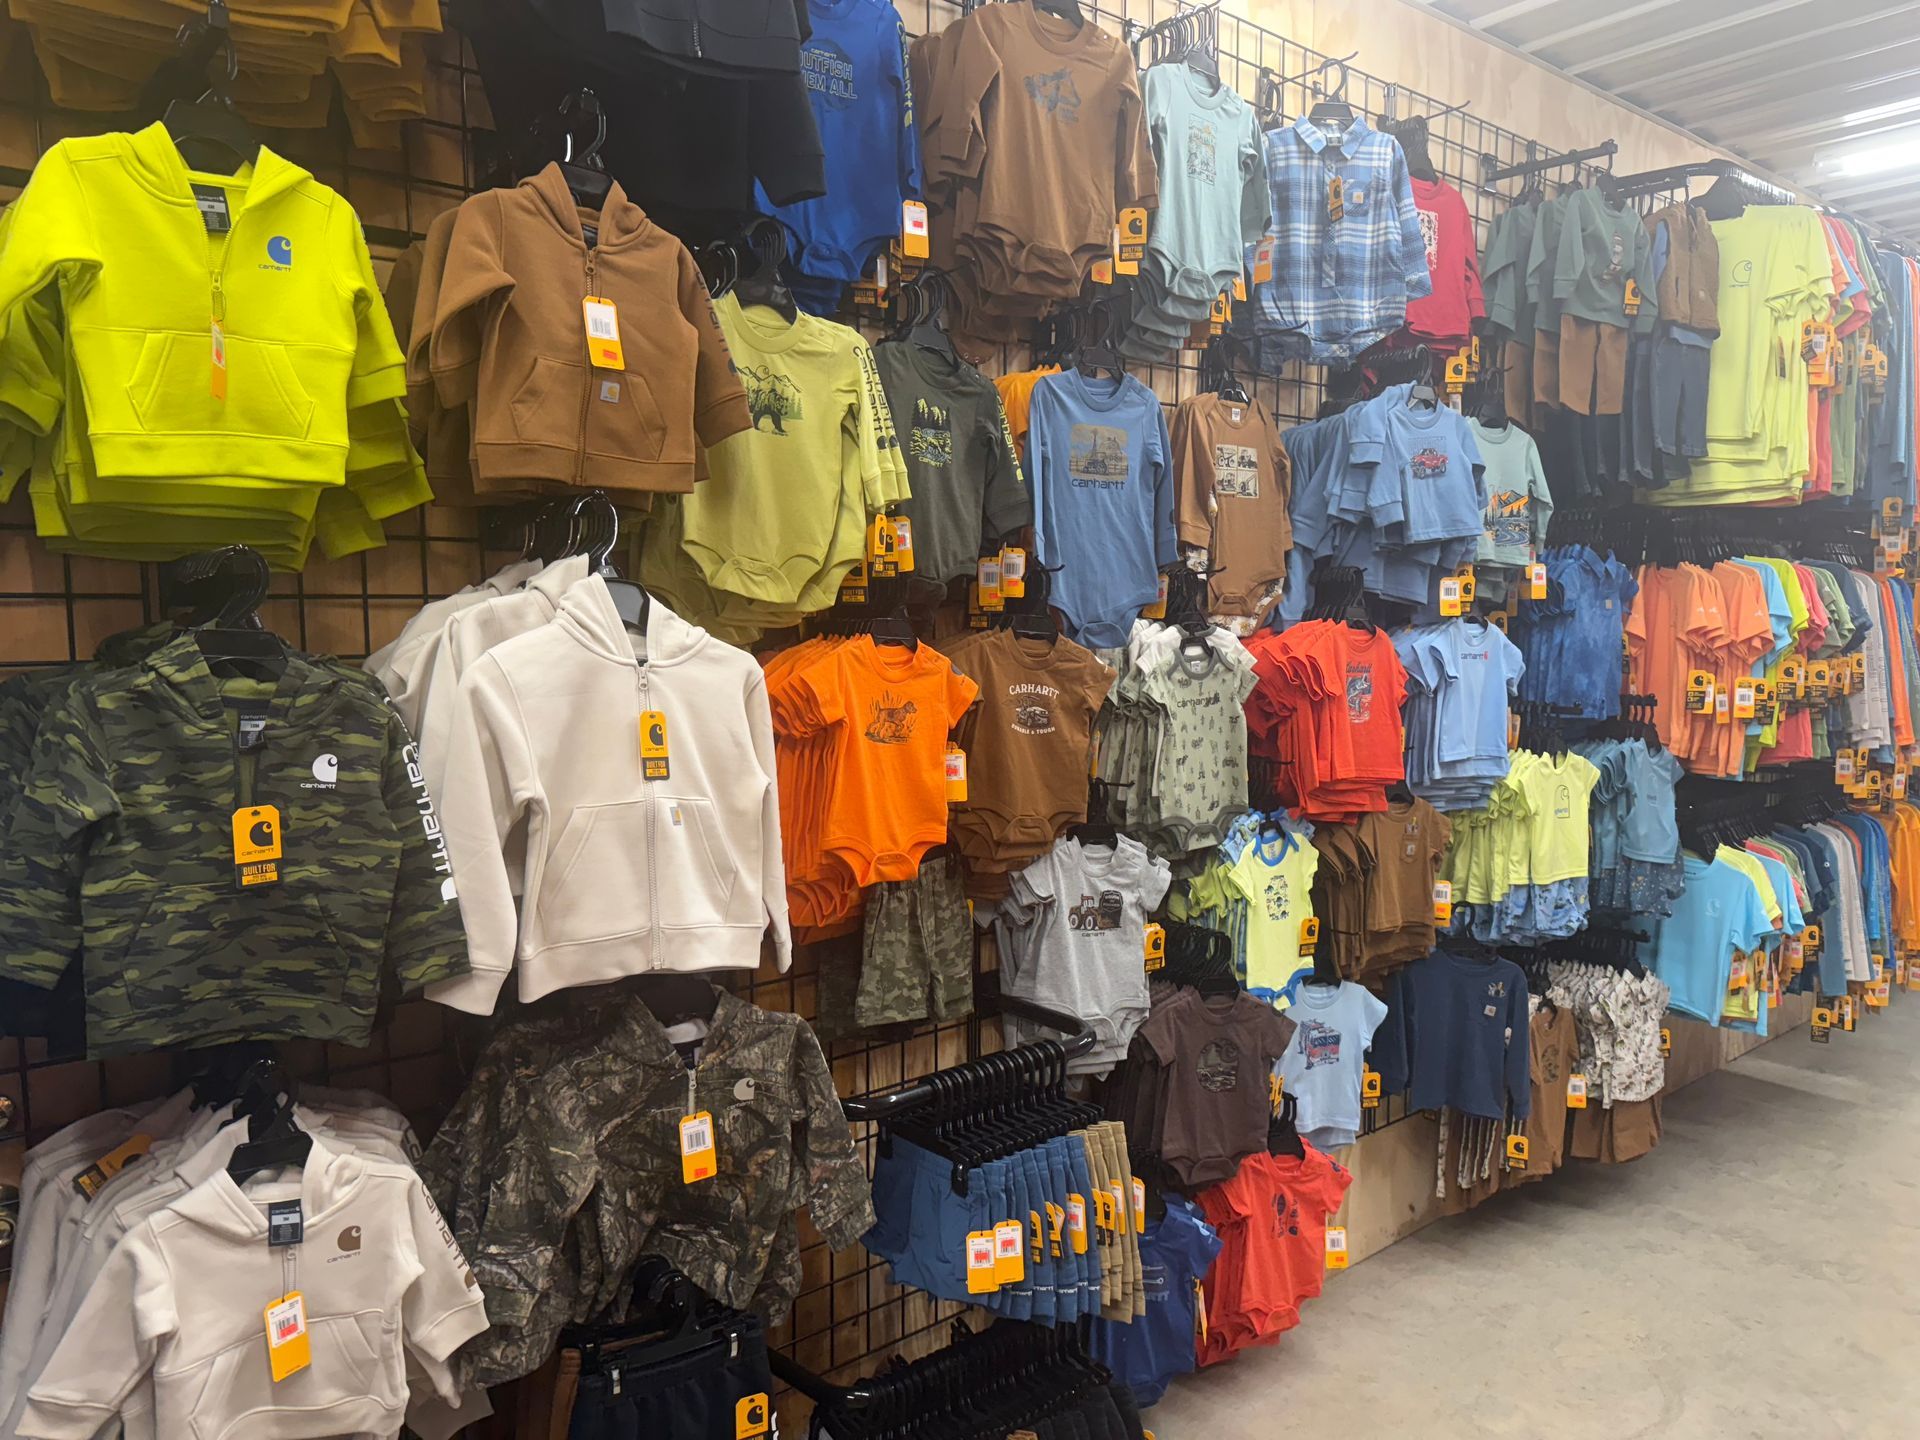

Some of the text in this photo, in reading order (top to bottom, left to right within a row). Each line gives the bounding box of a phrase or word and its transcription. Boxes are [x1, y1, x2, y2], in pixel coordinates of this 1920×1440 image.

[829, 78, 858, 99] ALL
[258, 263, 291, 273] carhartt
[853, 346, 884, 433] carhartt
[918, 456, 943, 468] carhartt
[1071, 477, 1126, 491] carhartt
[1009, 683, 1060, 700] CARHARTT
[1036, 726, 1056, 735] TOUGH
[300, 782, 336, 790] carhartt
[402, 744, 452, 873] carhartt
[241, 847, 275, 857] carhartt
[243, 862, 276, 876] BUILT FOR
[326, 1250, 361, 1264] carhartt
